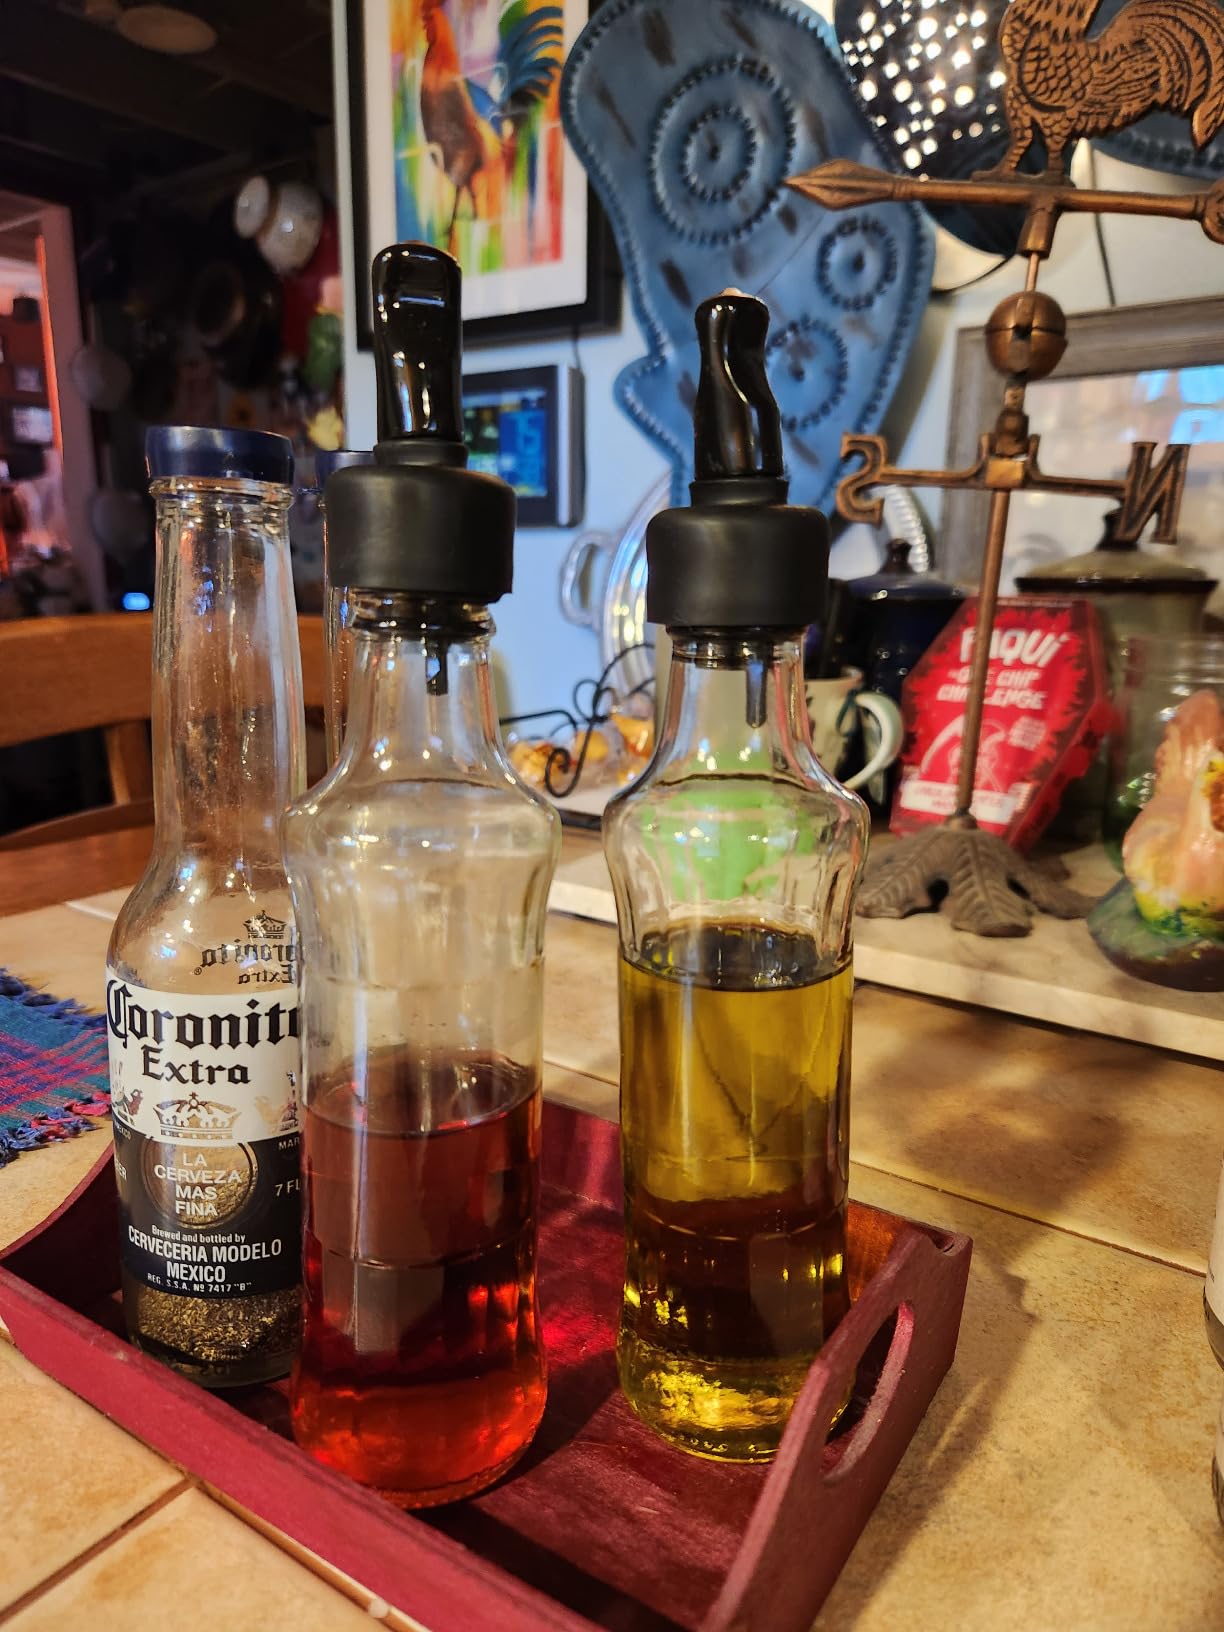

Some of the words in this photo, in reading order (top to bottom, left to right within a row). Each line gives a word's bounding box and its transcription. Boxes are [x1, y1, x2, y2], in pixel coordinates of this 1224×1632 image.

[956, 666, 995, 685] OE
[936, 684, 1046, 710] CHAENGE
[140, 1044, 251, 1085] Extra
[183, 1152, 208, 1167] LA
[153, 1164, 242, 1184] CERVEZA
[175, 1184, 218, 1200] MAS
[275, 1183, 284, 1197] 7
[175, 1200, 218, 1217] FINA
[128, 1225, 208, 1263] CERVECERIA
[212, 1239, 282, 1263] MODELO
[151, 1224, 181, 1241] Brewed
[181, 1232, 198, 1243] and
[200, 1233, 233, 1243] bottled
[234, 1233, 246, 1245] by
[147, 1272, 163, 1286] REG.
[166, 1280, 191, 1292] S.S.A.
[208, 1284, 231, 1292] 7417
[166, 1261, 226, 1283] MEXICO
